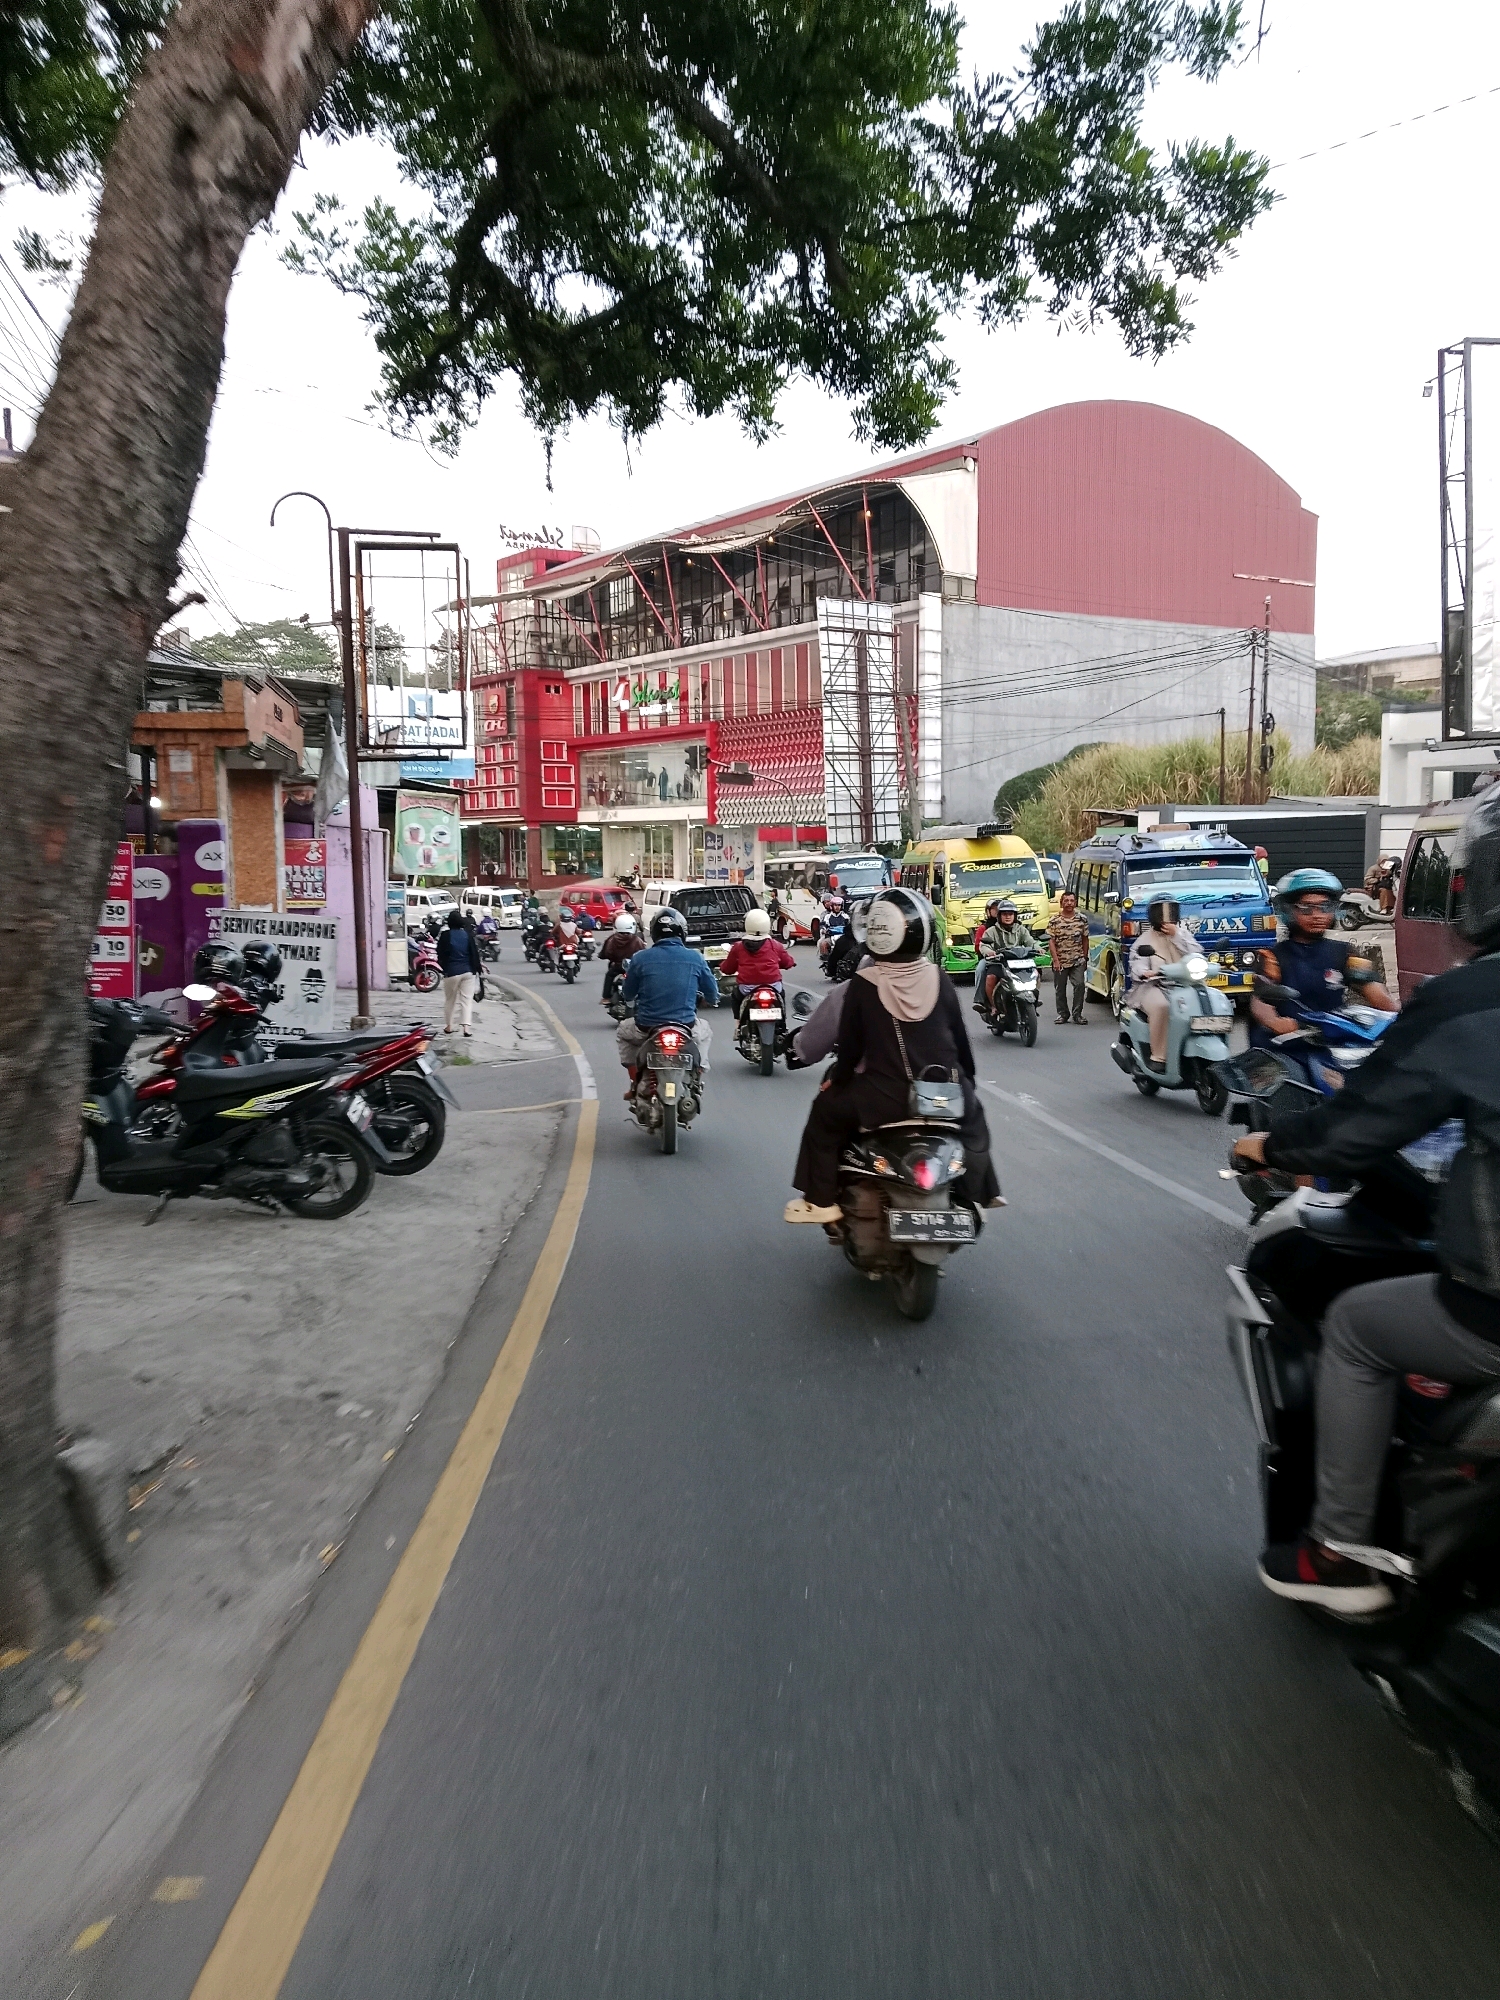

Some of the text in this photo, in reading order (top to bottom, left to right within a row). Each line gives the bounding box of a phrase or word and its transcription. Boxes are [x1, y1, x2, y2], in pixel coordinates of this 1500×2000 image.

[425, 726, 460, 739] GADAI
[106, 905, 125, 916] 30
[222, 917, 336, 940] SERVICE HANDPHONE
[1205, 916, 1248, 932] TAX
[108, 941, 125, 951] 10
[892, 1213, 903, 1226] F
